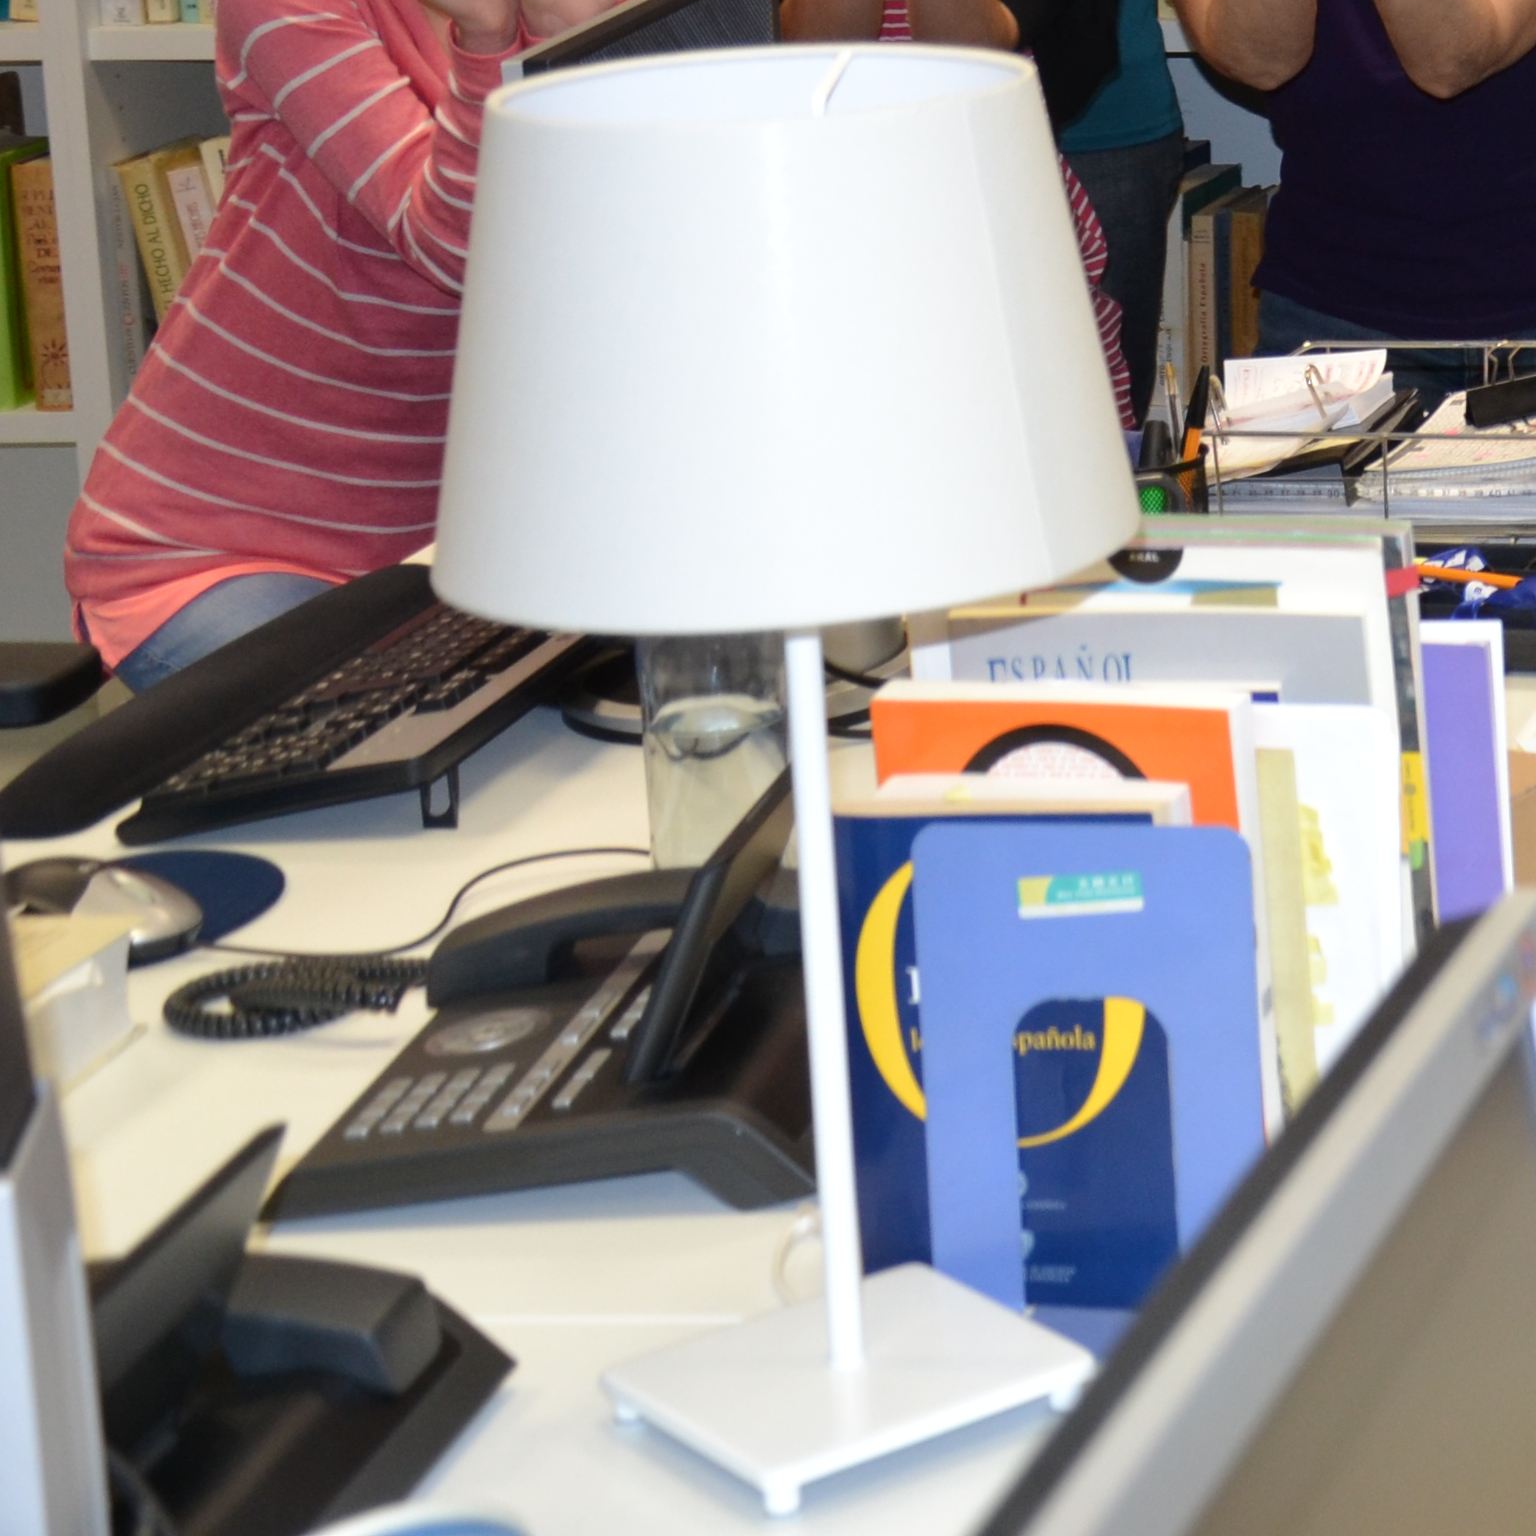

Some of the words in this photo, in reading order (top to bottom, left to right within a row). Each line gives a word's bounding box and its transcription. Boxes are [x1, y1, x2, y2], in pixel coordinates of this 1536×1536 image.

[134, 183, 156, 225] DICHO
[147, 228, 162, 245] AL
[151, 248, 175, 294] HECHO
